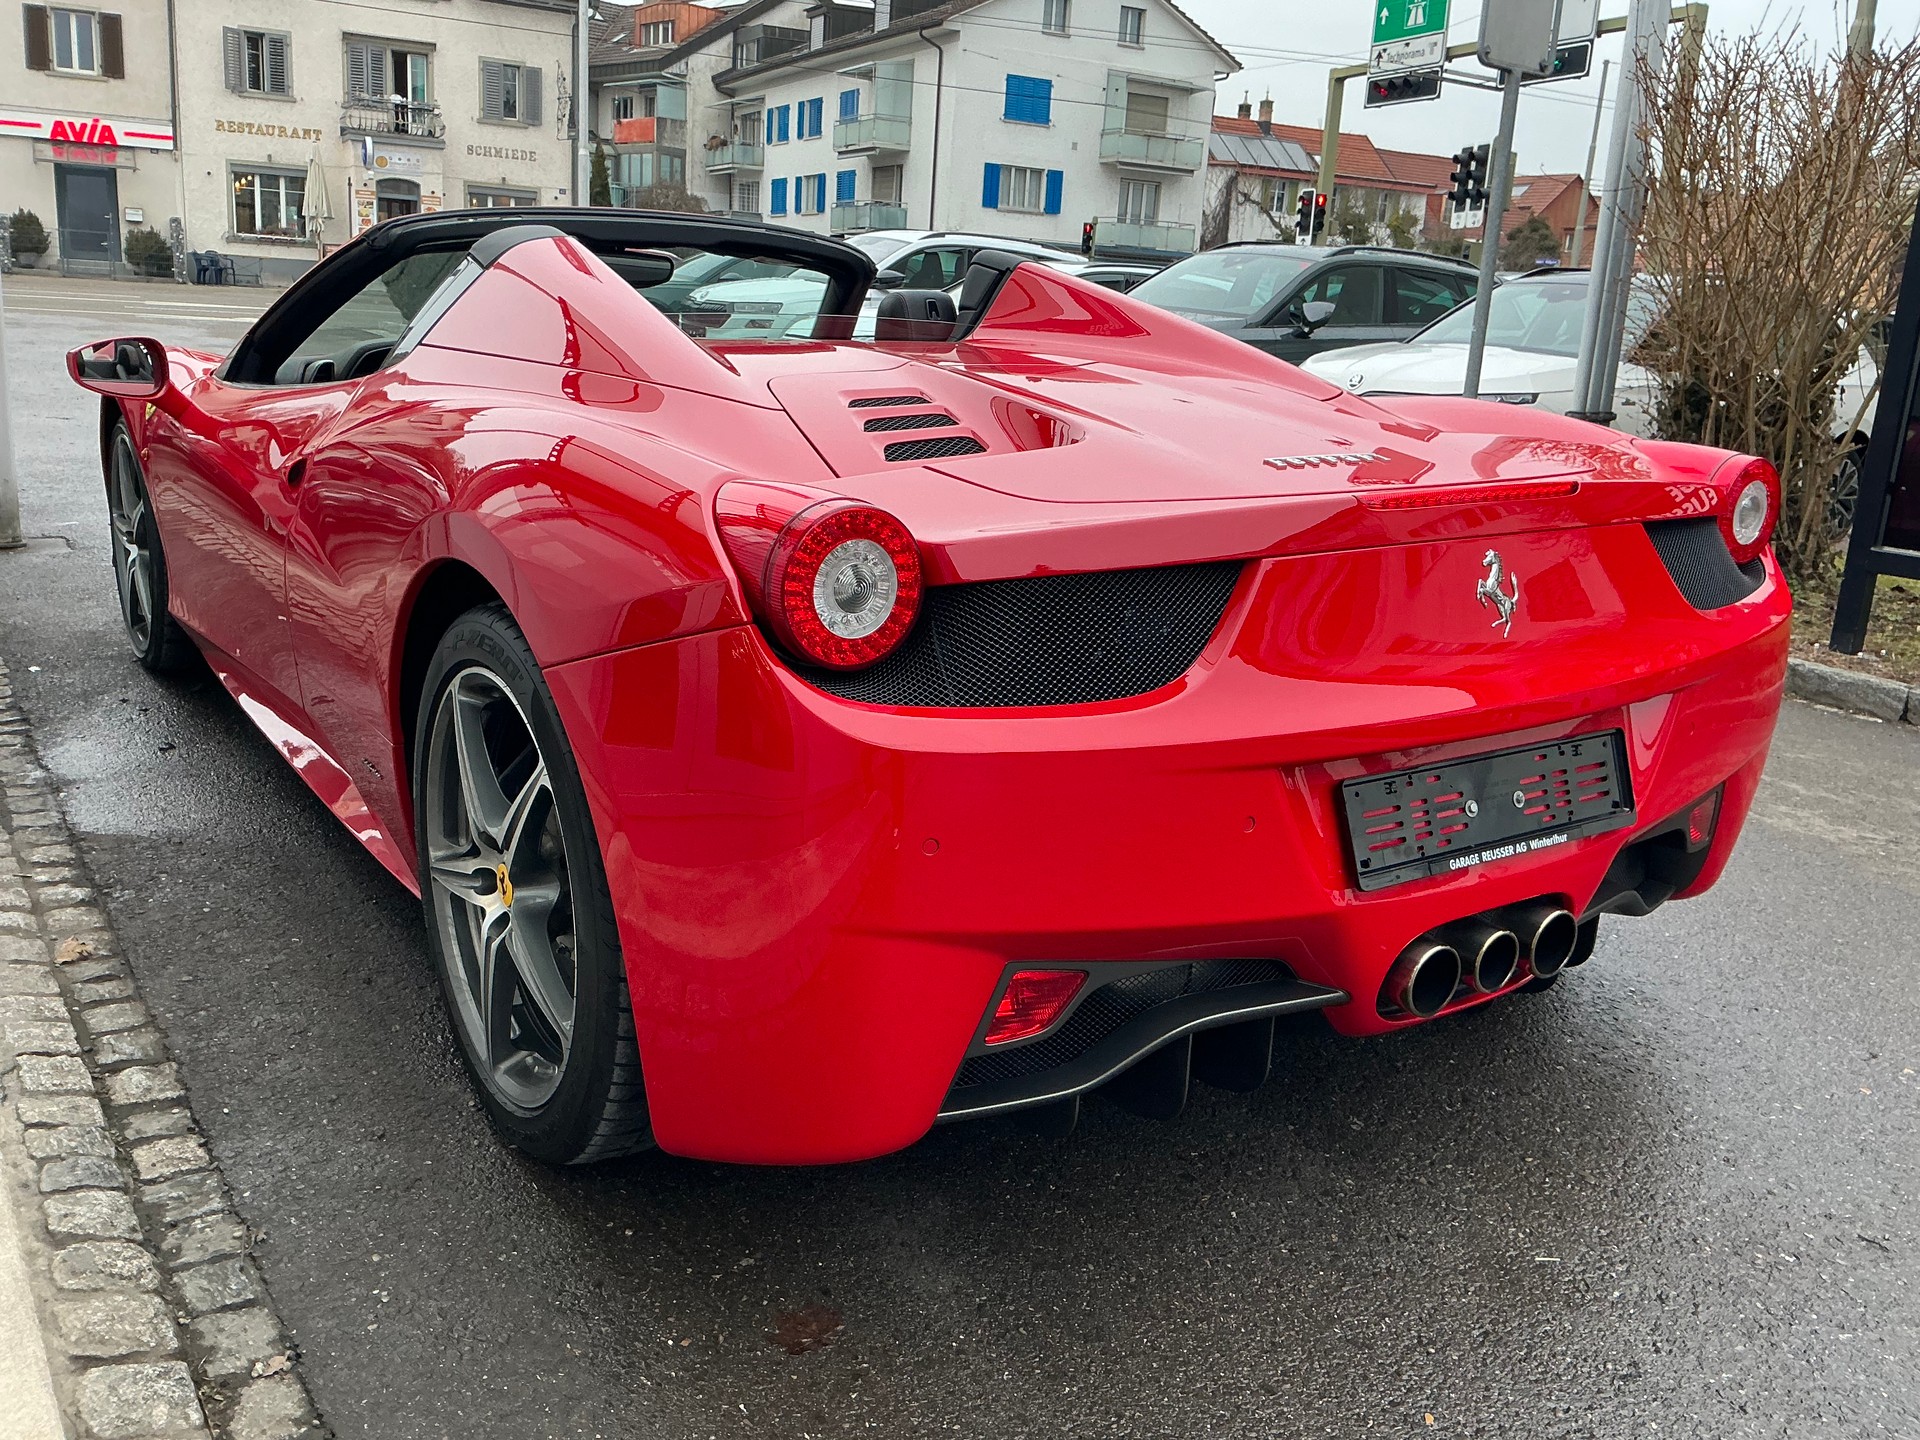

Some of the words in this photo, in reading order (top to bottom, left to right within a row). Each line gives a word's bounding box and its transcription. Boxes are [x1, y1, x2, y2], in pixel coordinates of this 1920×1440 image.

[1387, 49, 1425, 61] Technorama
[215, 119, 322, 141] RESTAURANT
[466, 144, 537, 162] SCHMIEDE
[1449, 853, 1480, 870] GARAGE
[1481, 845, 1515, 862] REUSSER
[1515, 842, 1528, 854] AG
[1529, 833, 1568, 850] Winterthur
